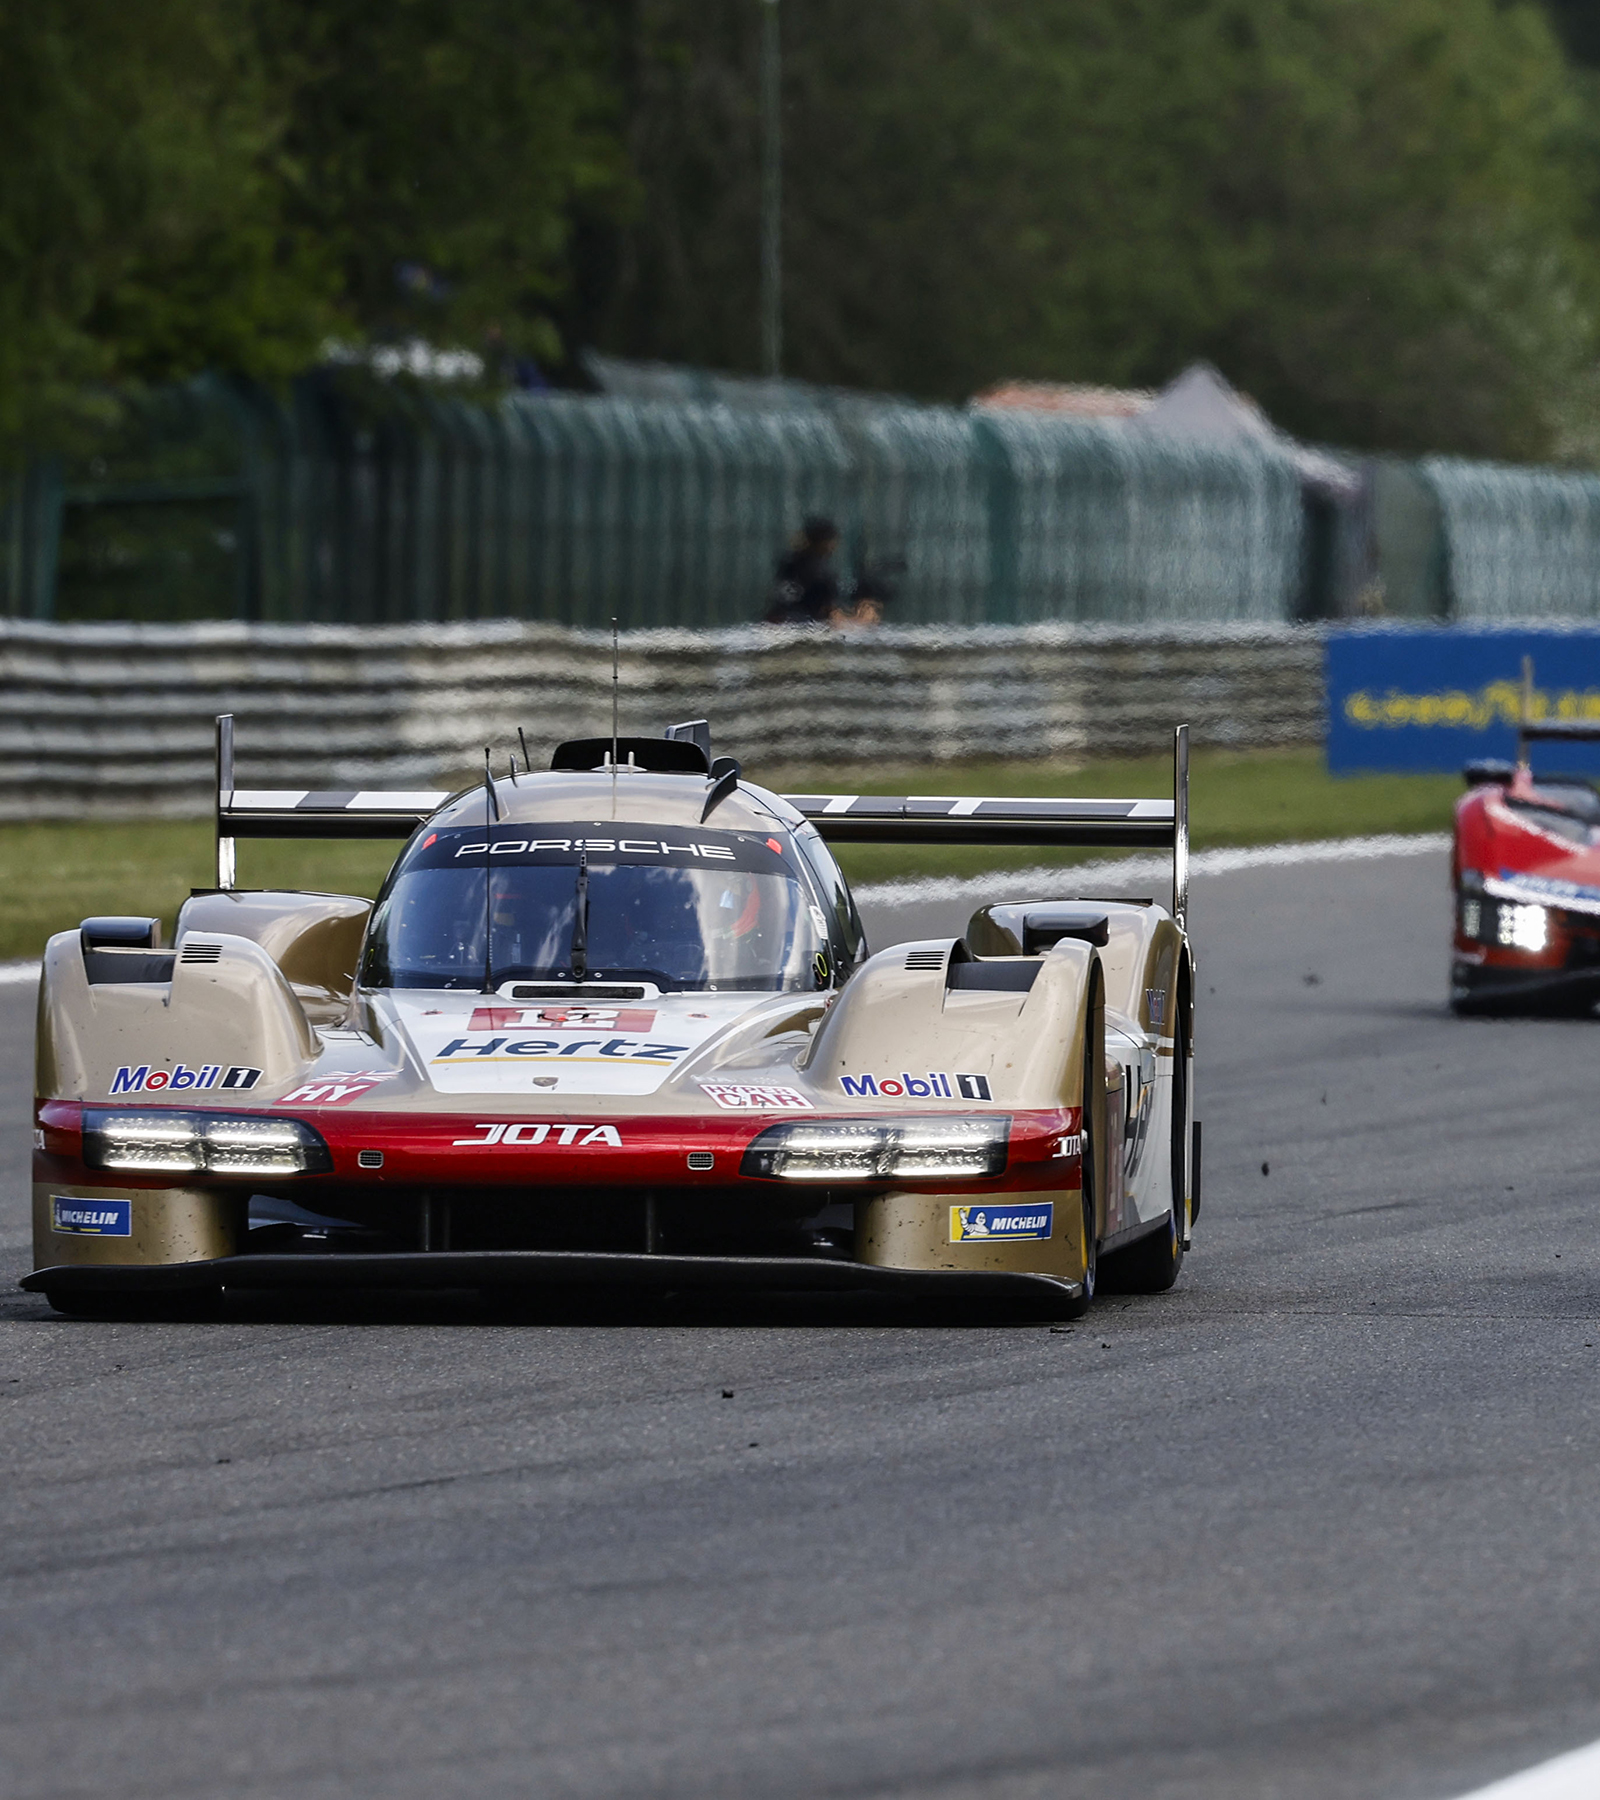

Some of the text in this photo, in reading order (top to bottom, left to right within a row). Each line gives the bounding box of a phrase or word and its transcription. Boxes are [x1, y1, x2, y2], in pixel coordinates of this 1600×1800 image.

[454, 839, 737, 860] PORSCHE
[502, 1009, 620, 1029] 12
[436, 1037, 690, 1061] Hertz
[110, 1065, 220, 1094] Mobil
[841, 1073, 953, 1098] Mobil
[282, 1084, 369, 1102] HY
[706, 1086, 791, 1095] HYPER
[716, 1093, 807, 1107] CAR
[452, 1123, 623, 1147] JOTA
[61, 1209, 119, 1225] MICHELIN
[990, 1215, 1048, 1231] MICHELIN
